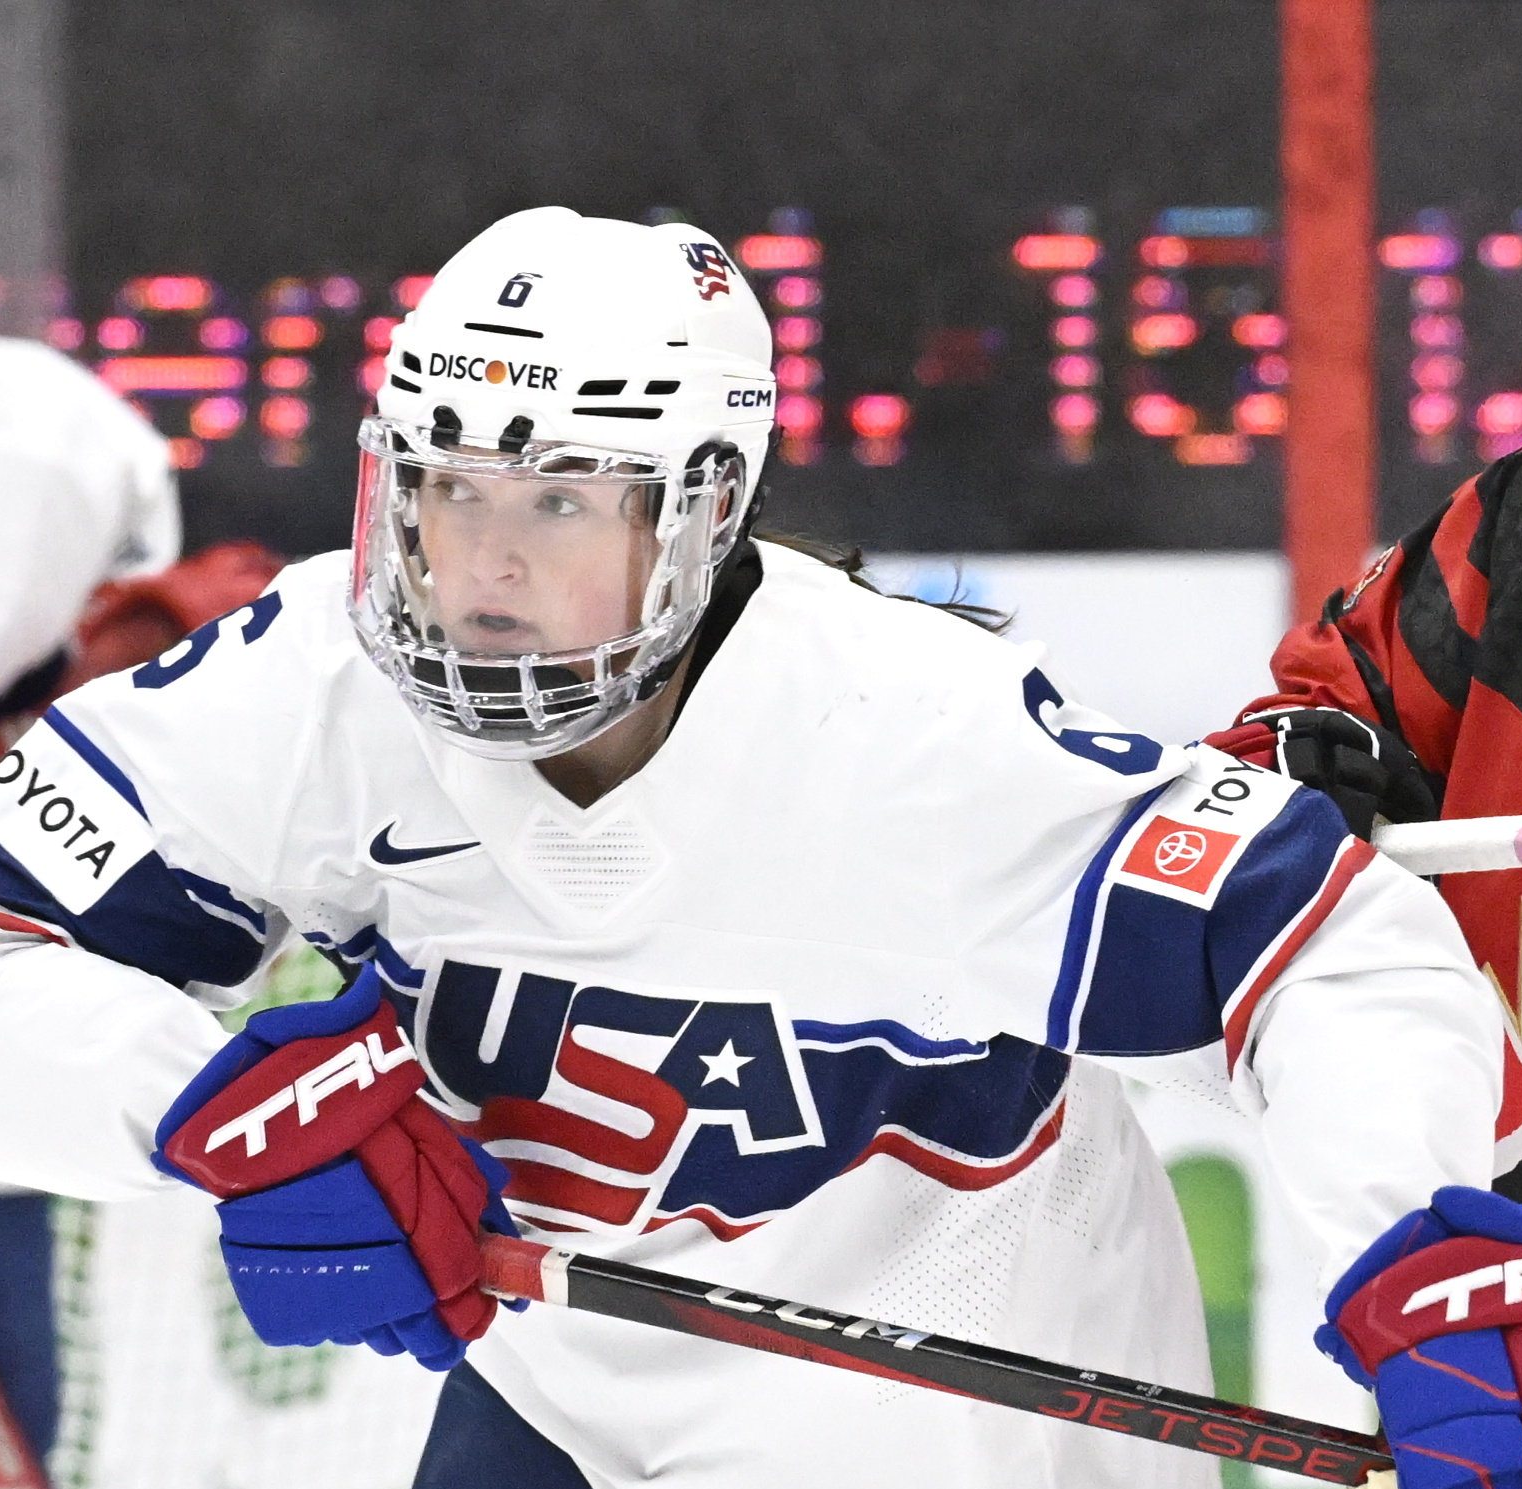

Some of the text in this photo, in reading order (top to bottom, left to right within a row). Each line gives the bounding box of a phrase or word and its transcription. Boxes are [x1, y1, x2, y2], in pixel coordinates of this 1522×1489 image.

[497, 272, 543, 308] 6
[429, 352, 558, 391] DISCOVER
[726, 389, 773, 407] CCM
[1193, 756, 1265, 816] TOY
[204, 1024, 419, 1158] TRU
[415, 958, 816, 1229] USA
[704, 1286, 936, 1351] CCM
